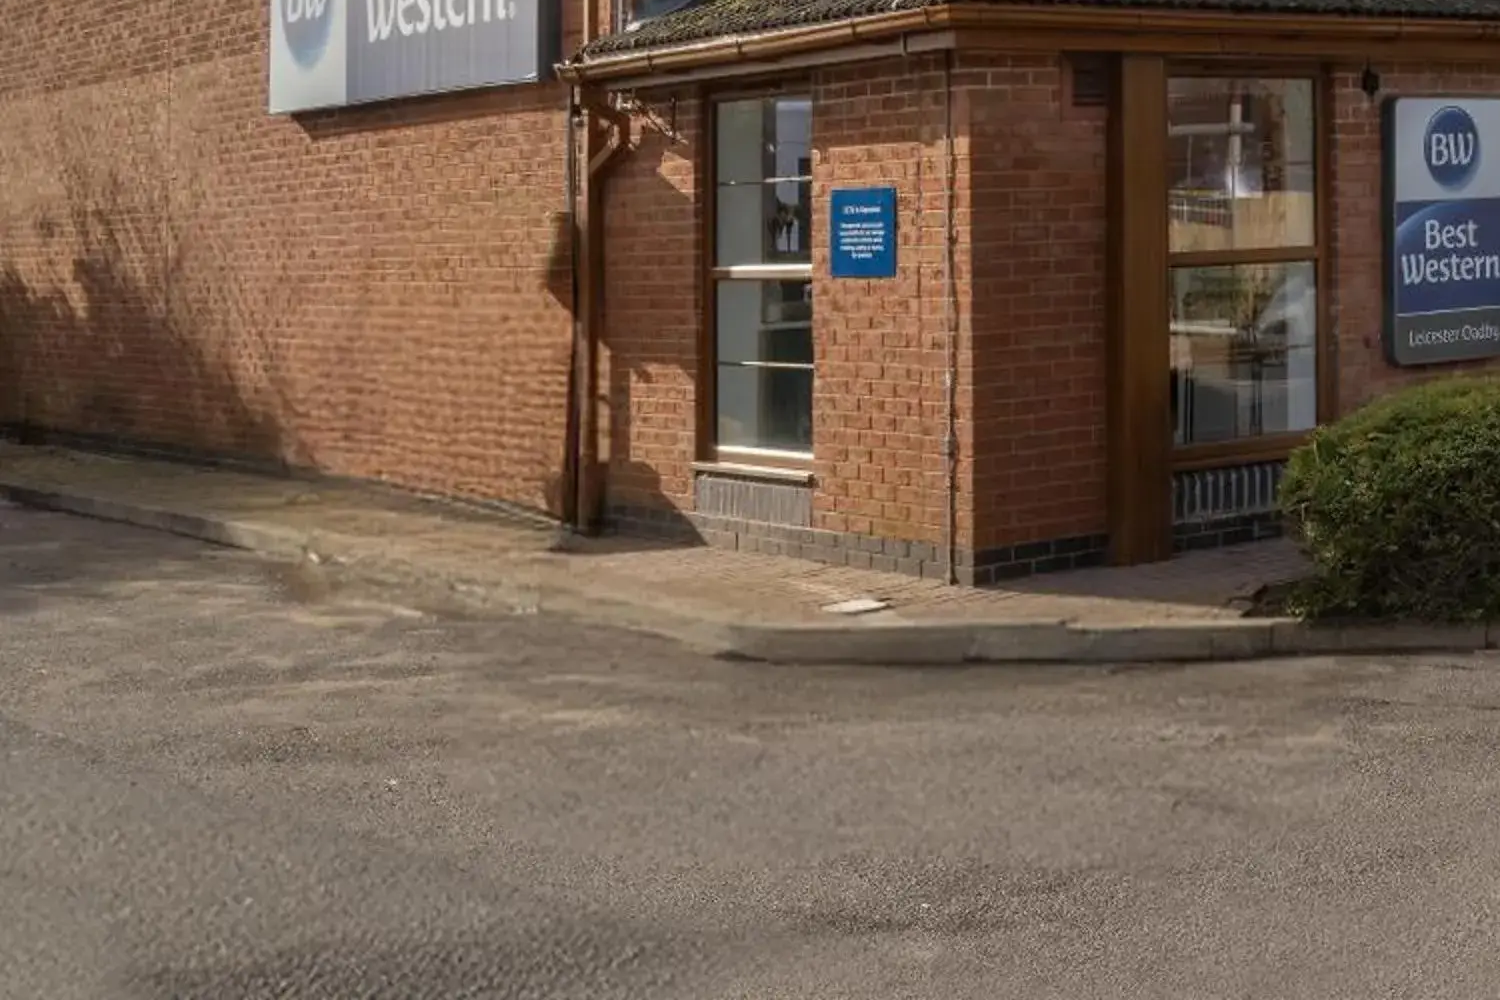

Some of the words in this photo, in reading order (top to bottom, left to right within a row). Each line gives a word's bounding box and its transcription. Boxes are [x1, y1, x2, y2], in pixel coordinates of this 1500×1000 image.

[1430, 132, 1473, 166] BW
[1425, 219, 1478, 250] Best
[1408, 328, 1460, 348] Leicester
[1461, 322, 1500, 341] Oadby
